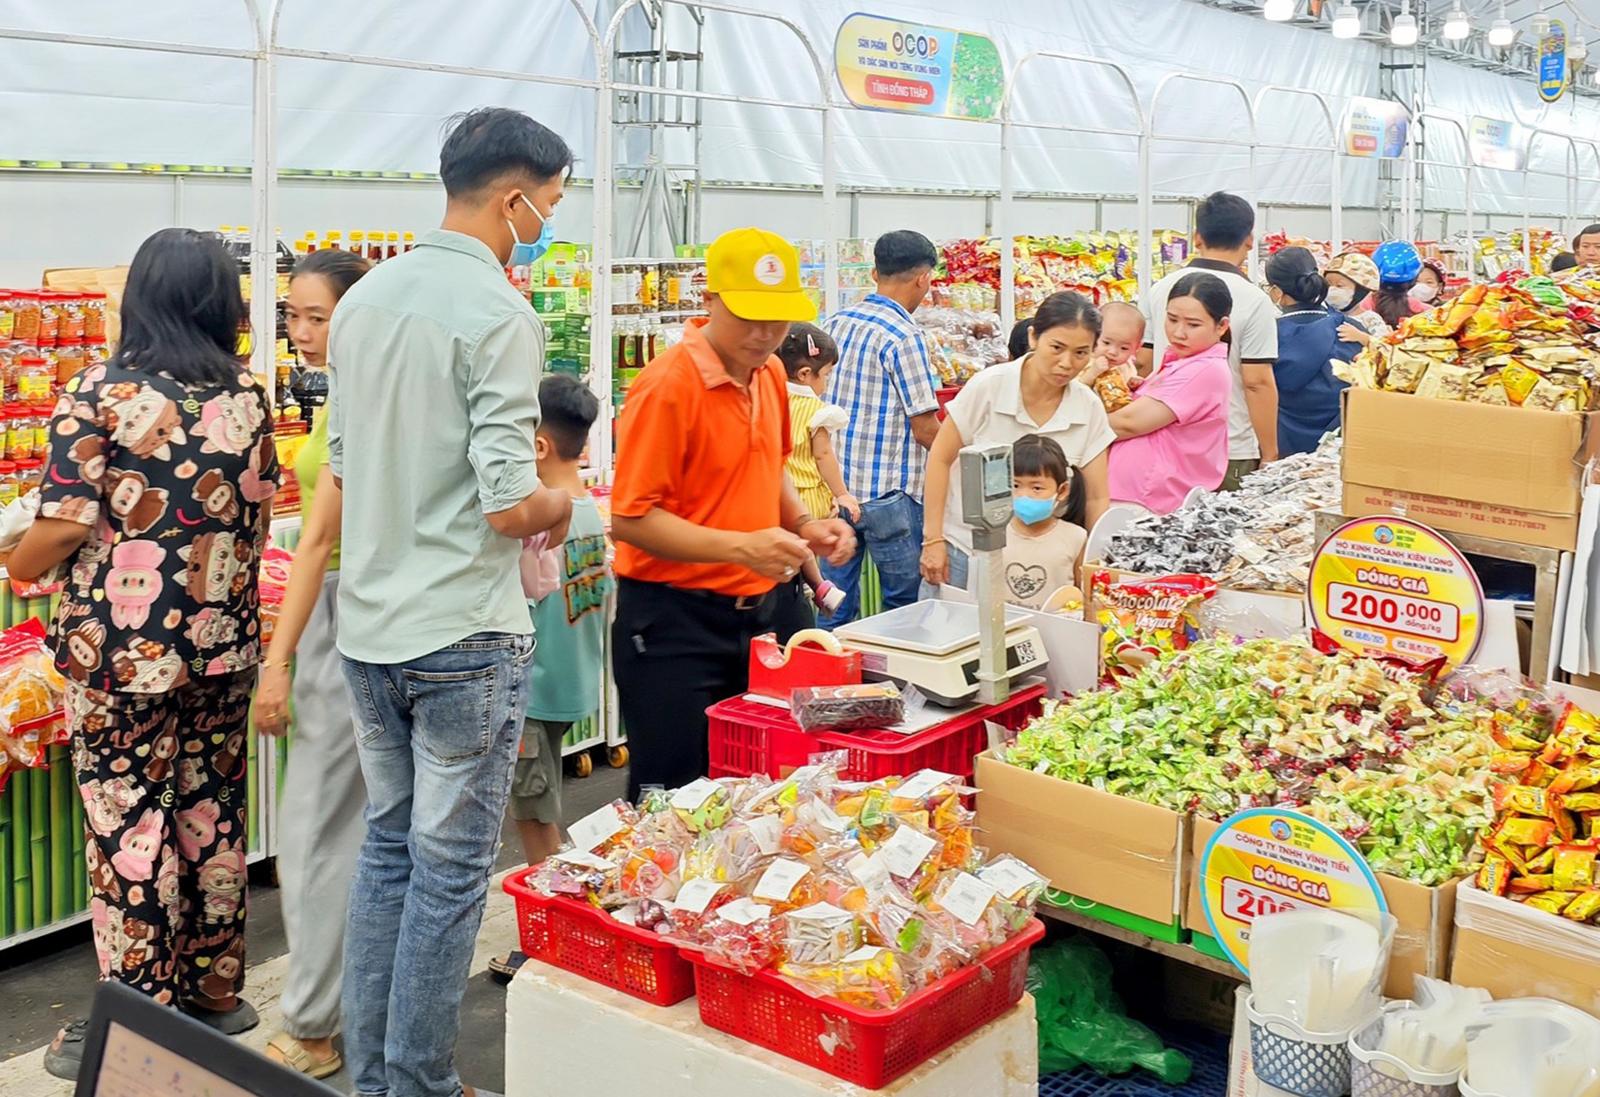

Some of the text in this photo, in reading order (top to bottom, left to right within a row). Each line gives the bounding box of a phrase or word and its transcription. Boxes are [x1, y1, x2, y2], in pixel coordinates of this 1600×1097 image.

[892, 32, 938, 57] OCOP
[1351, 543, 1371, 553] KINH
[1373, 547, 1405, 558] DOANH
[1429, 556, 1454, 567] LONG
[1401, 577, 1429, 594] GIÁ
[1108, 589, 1184, 611] Chocolate
[1135, 611, 1179, 633] Yogurt
[1405, 620, 1442, 633] đồng/kg
[1236, 833, 1263, 847] CÔNG
[1266, 841, 1276, 851] TY
[1279, 844, 1302, 858] TNHH
[1330, 860, 1350, 873] TIẾN
[1301, 881, 1330, 902] GIÁ
